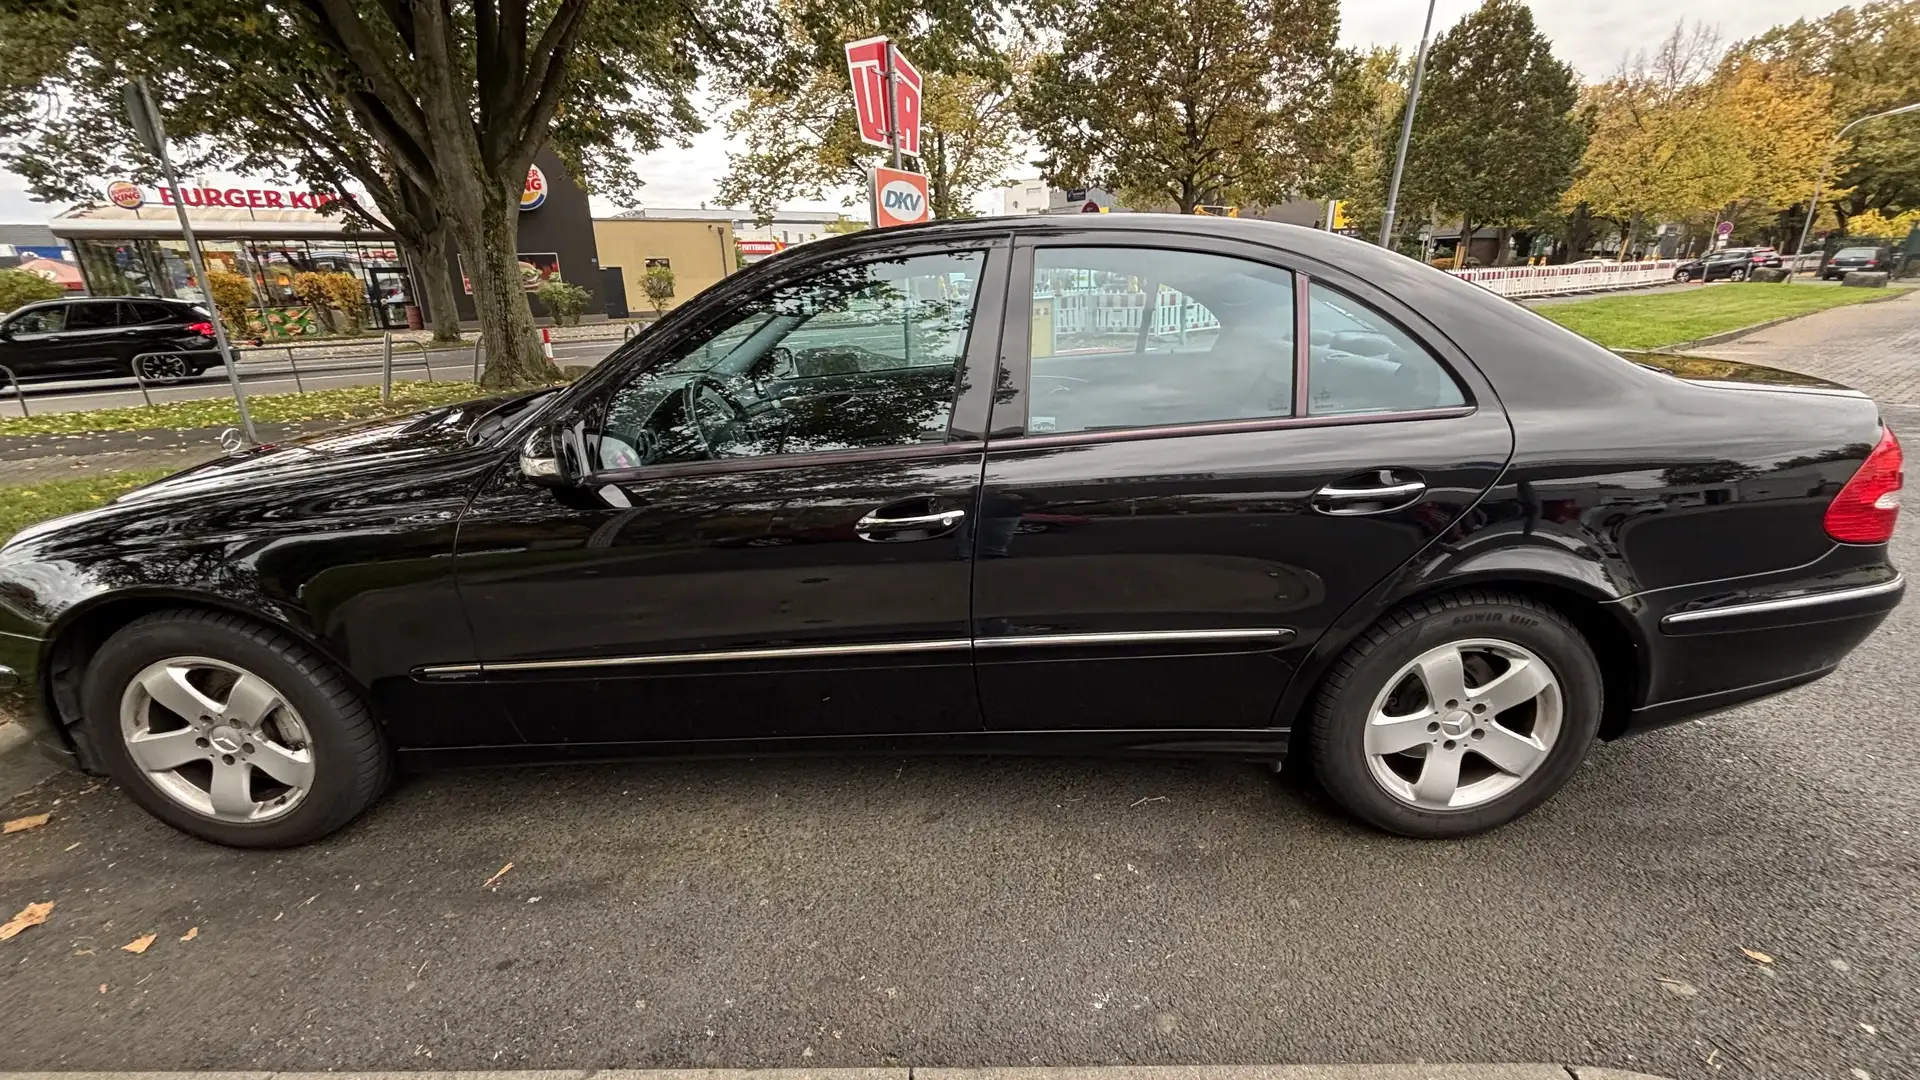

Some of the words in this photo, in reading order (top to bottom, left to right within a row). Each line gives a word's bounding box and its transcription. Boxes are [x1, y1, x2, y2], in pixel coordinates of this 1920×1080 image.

[113, 191, 141, 202] KING
[884, 189, 922, 212] DKV
[1508, 614, 1540, 628] UHP
